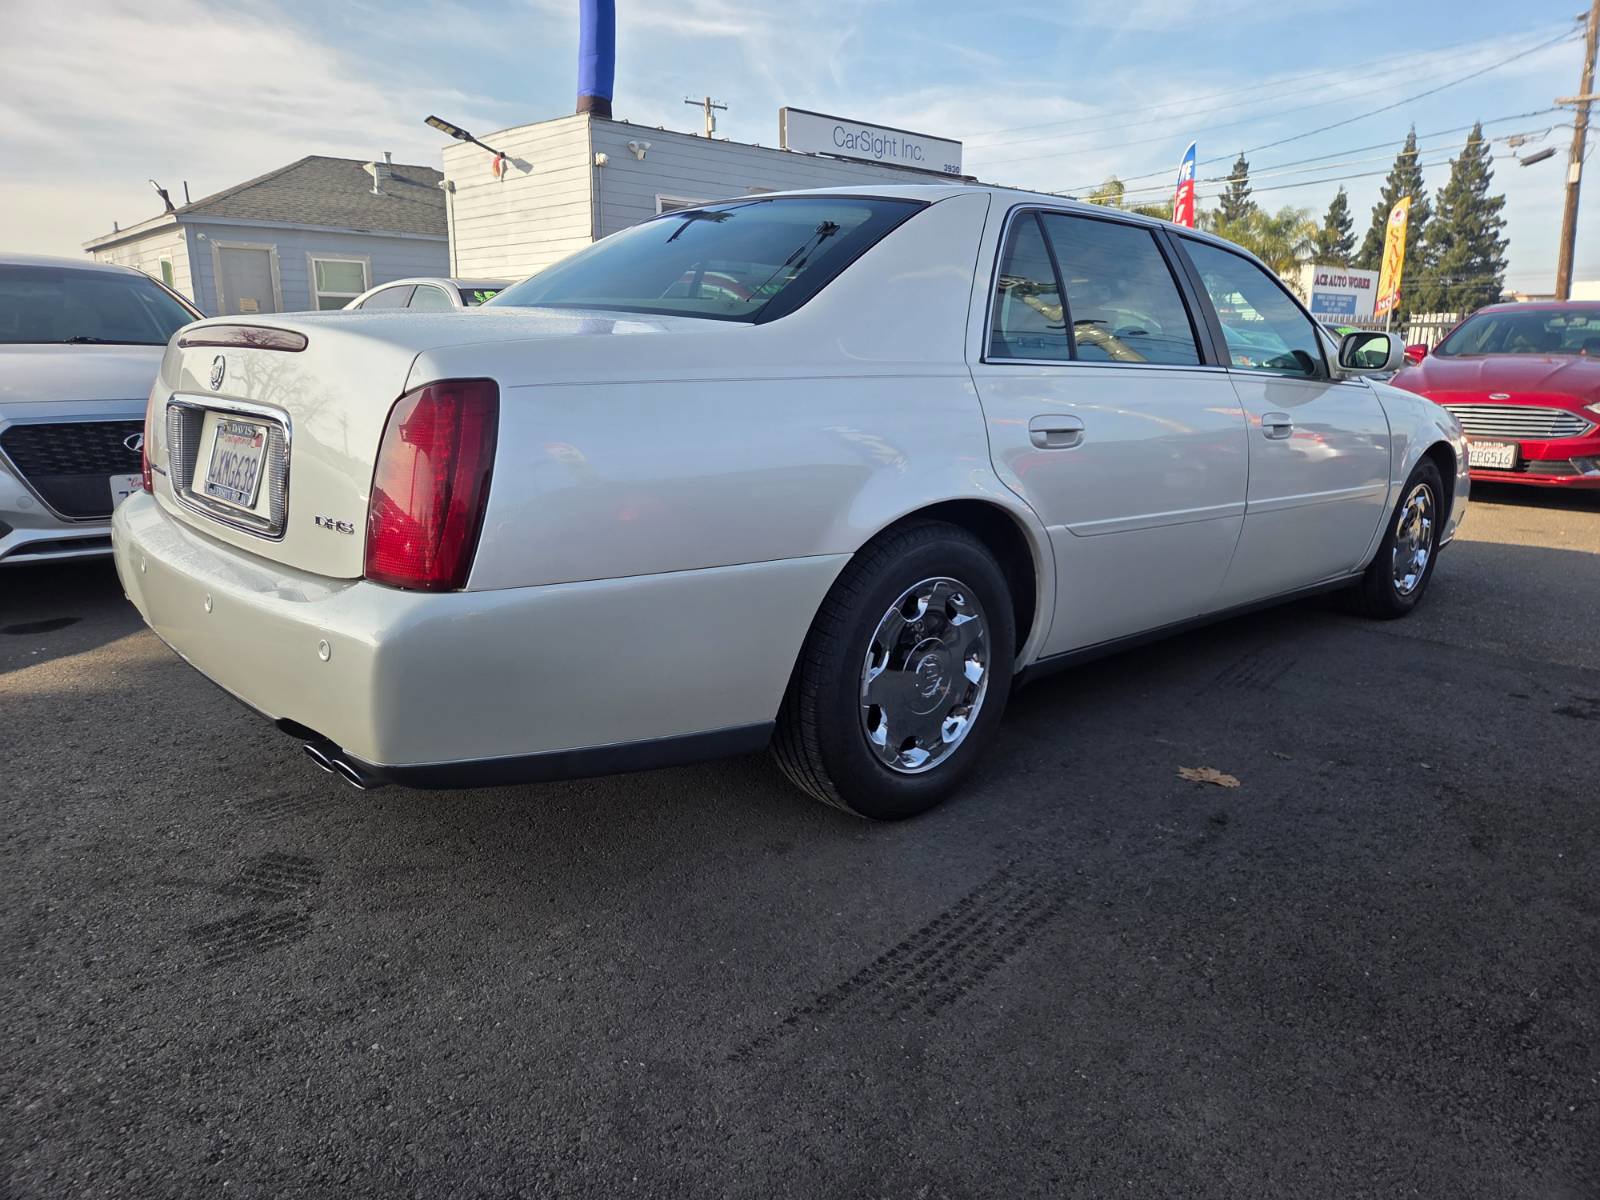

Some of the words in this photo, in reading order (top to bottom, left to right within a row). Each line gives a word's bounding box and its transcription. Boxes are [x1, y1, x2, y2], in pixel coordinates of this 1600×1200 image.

[833, 126, 898, 159] CarSight
[901, 139, 925, 161] Inc.
[943, 164, 960, 174] 3930
[1314, 274, 1328, 286] ACE
[1329, 275, 1347, 288] AUTO
[1348, 276, 1370, 289] WORKS
[231, 423, 253, 436] DAVIS
